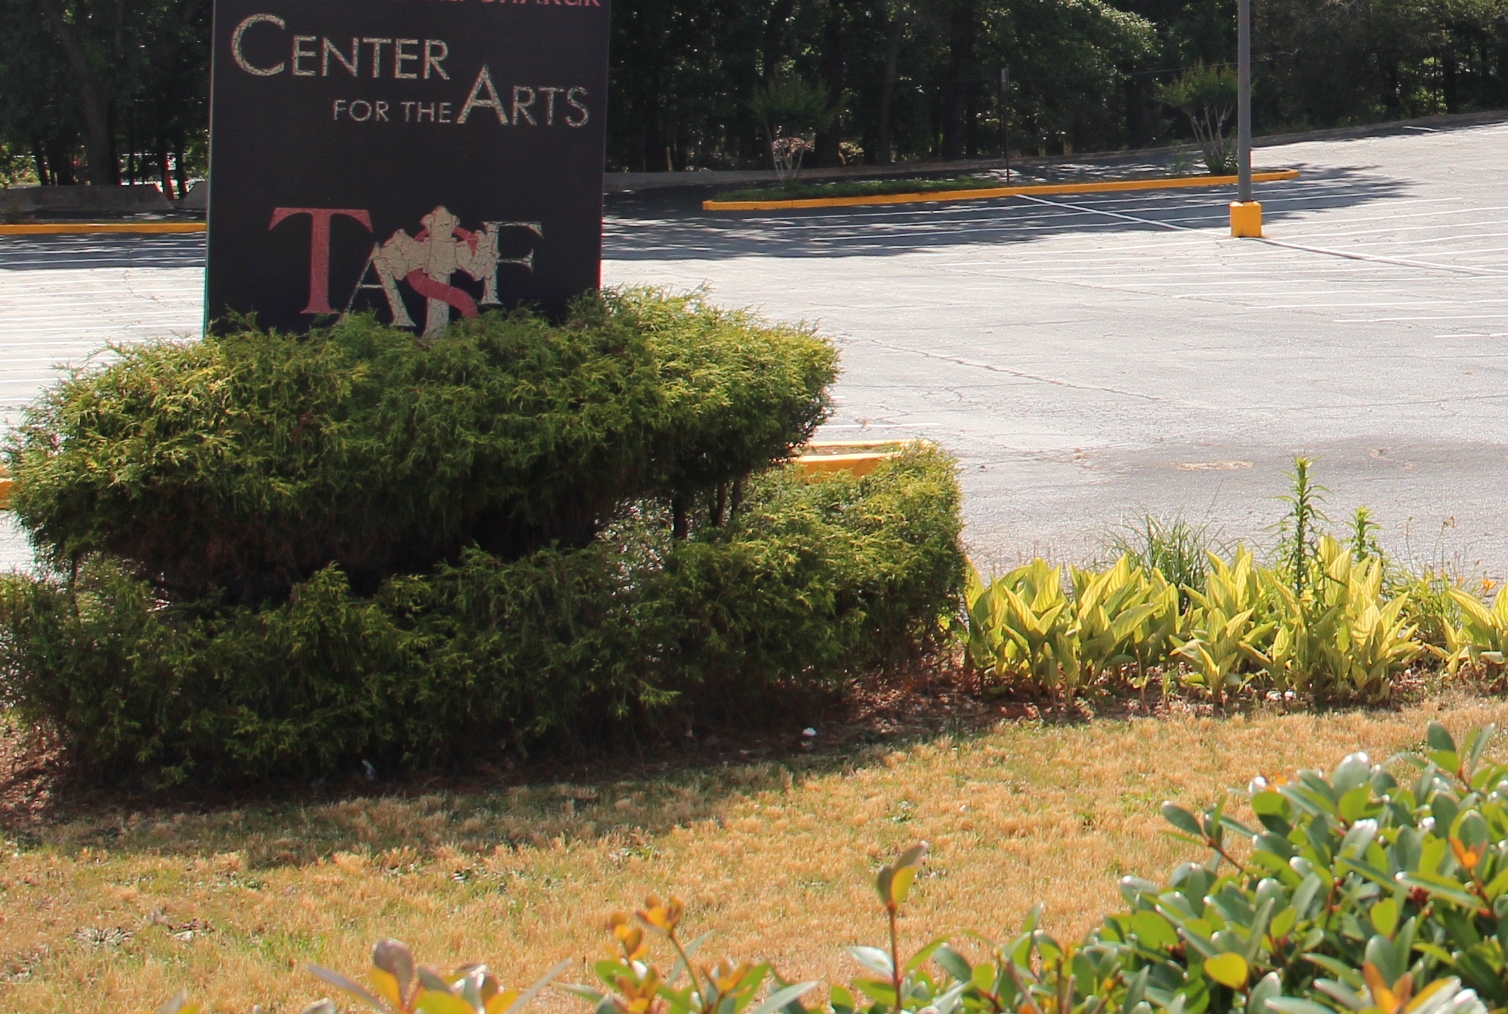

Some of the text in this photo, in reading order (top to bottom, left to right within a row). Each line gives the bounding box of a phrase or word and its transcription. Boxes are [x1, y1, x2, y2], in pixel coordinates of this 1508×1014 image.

[231, 13, 450, 80] CENTER
[333, 64, 590, 127] FOR THE ARTS
